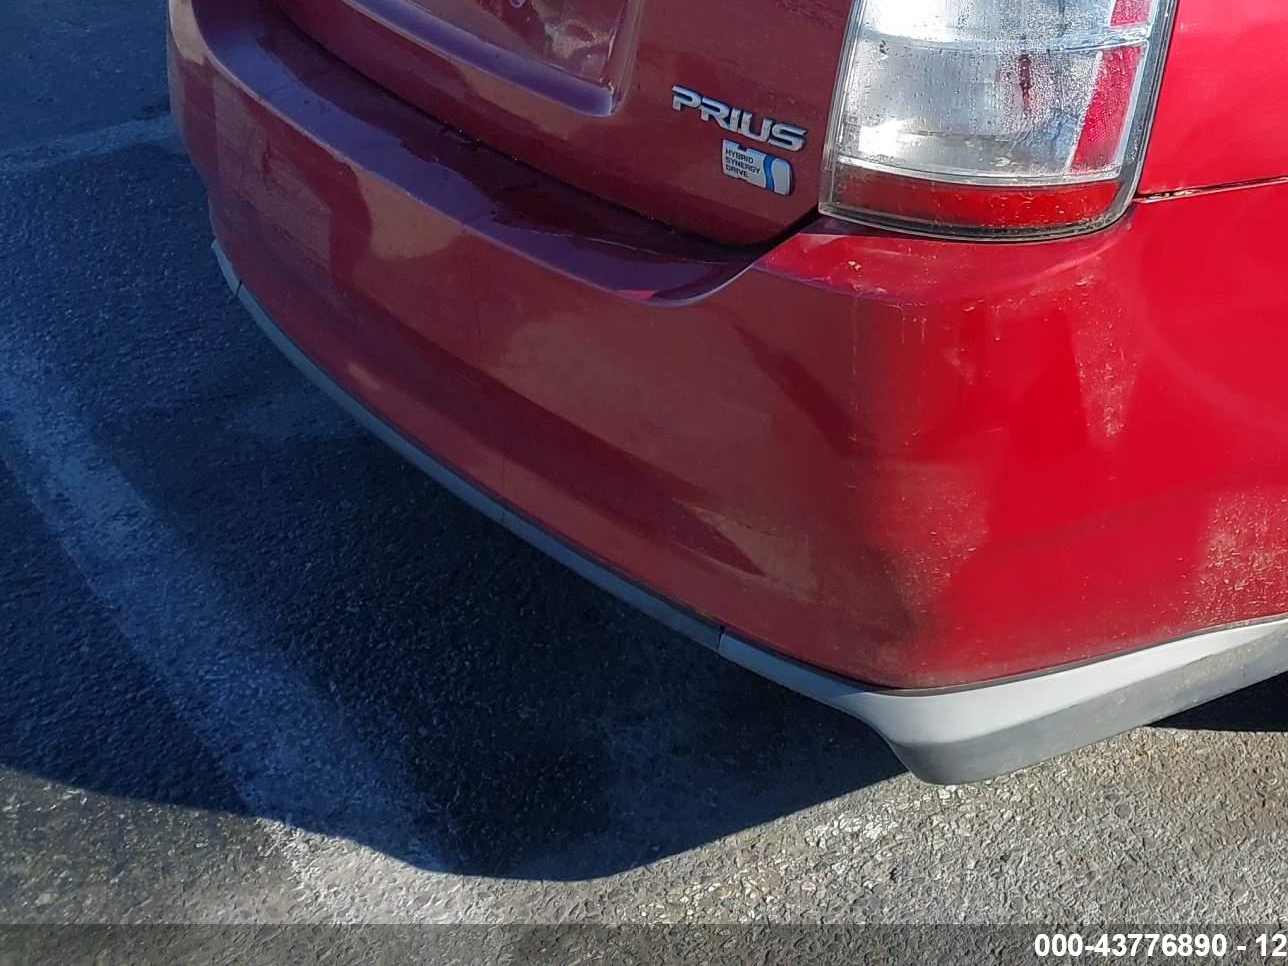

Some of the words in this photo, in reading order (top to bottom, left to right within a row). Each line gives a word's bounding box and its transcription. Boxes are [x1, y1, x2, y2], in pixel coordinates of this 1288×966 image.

[672, 85, 809, 152] PRIUS
[725, 149, 754, 165] HYBRID
[725, 156, 761, 175] SYNERGY
[725, 164, 750, 178] DRIVE
